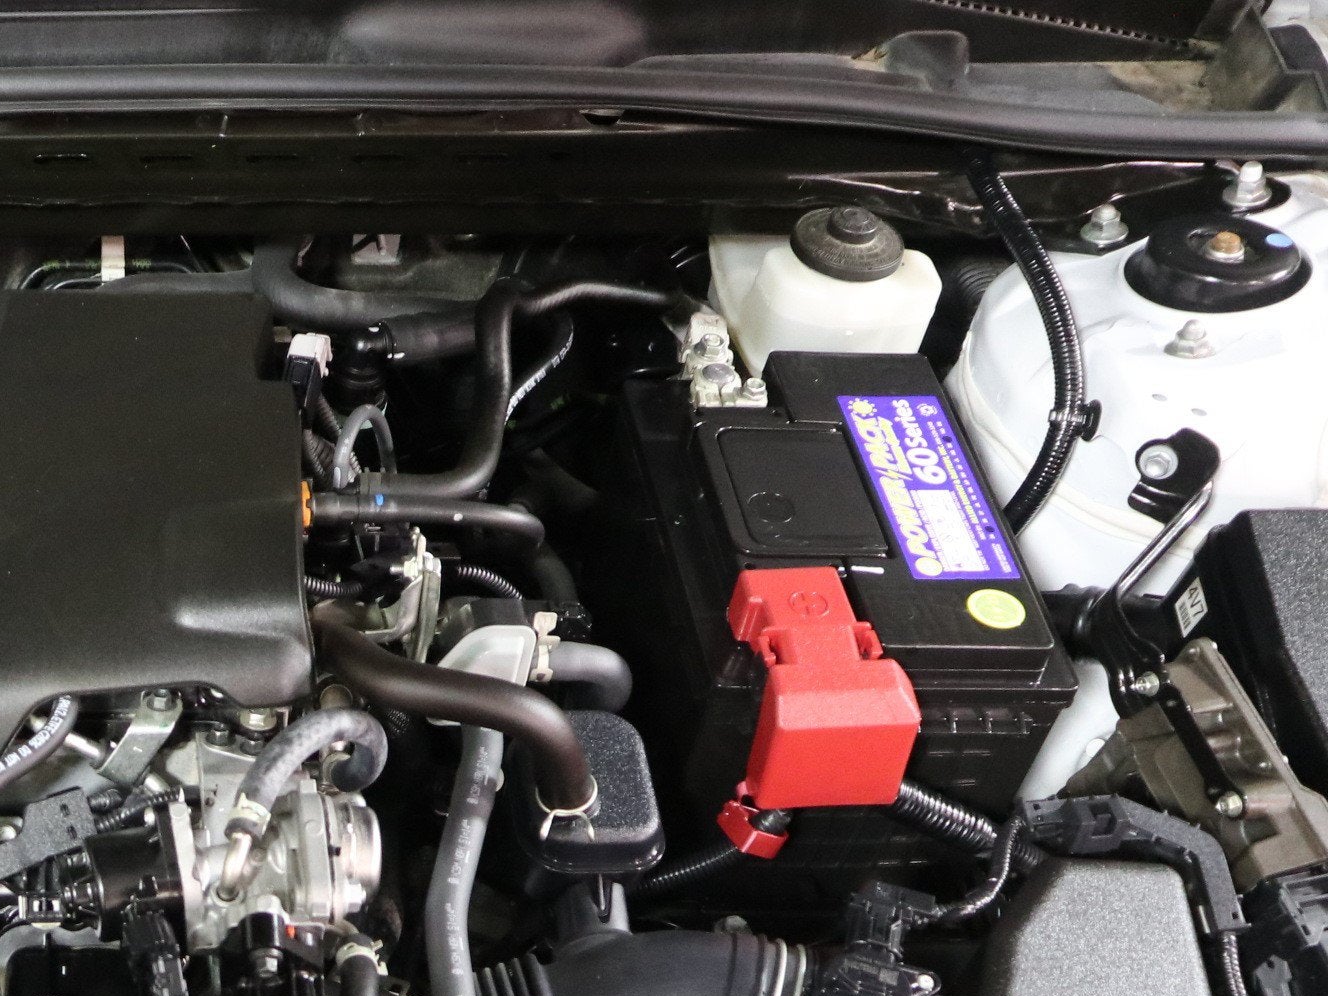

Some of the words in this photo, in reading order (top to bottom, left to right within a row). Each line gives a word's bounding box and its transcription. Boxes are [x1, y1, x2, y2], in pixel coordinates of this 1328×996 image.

[850, 413, 898, 472] PACK
[891, 398, 927, 448] Series
[906, 448, 948, 485] 60
[878, 477, 937, 558] POWER
